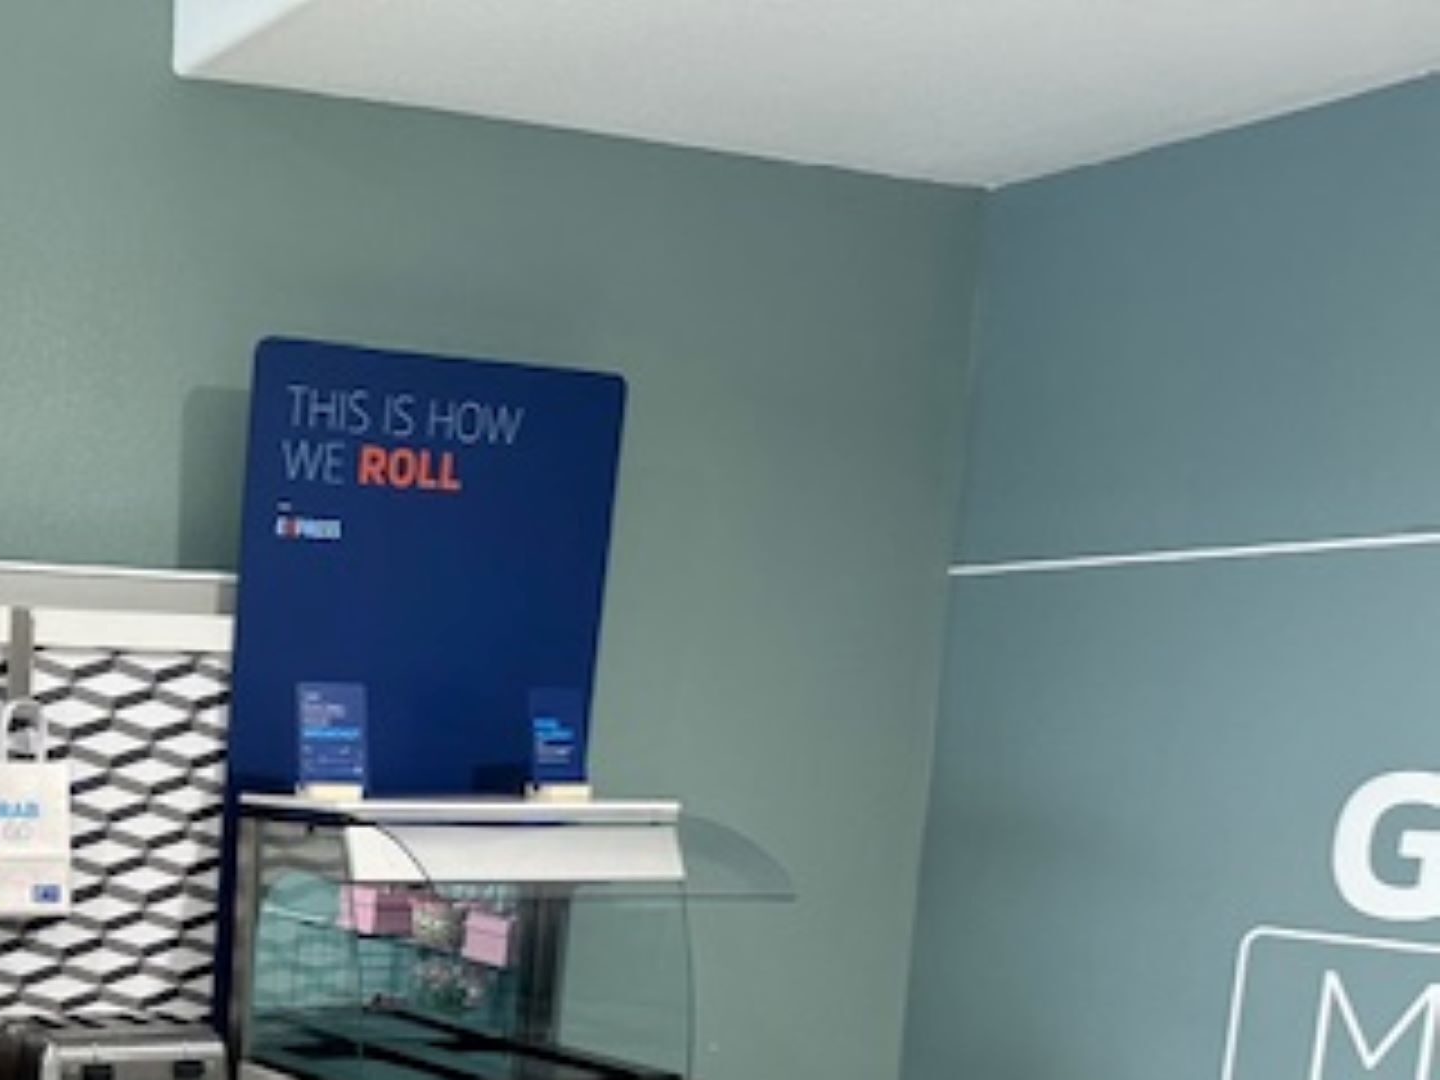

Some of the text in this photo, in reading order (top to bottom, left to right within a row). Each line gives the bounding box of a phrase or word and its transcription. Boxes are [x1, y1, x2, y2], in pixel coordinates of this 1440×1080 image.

[286, 384, 526, 445] THIS IS HOW
[281, 439, 462, 491] WE ROLL
